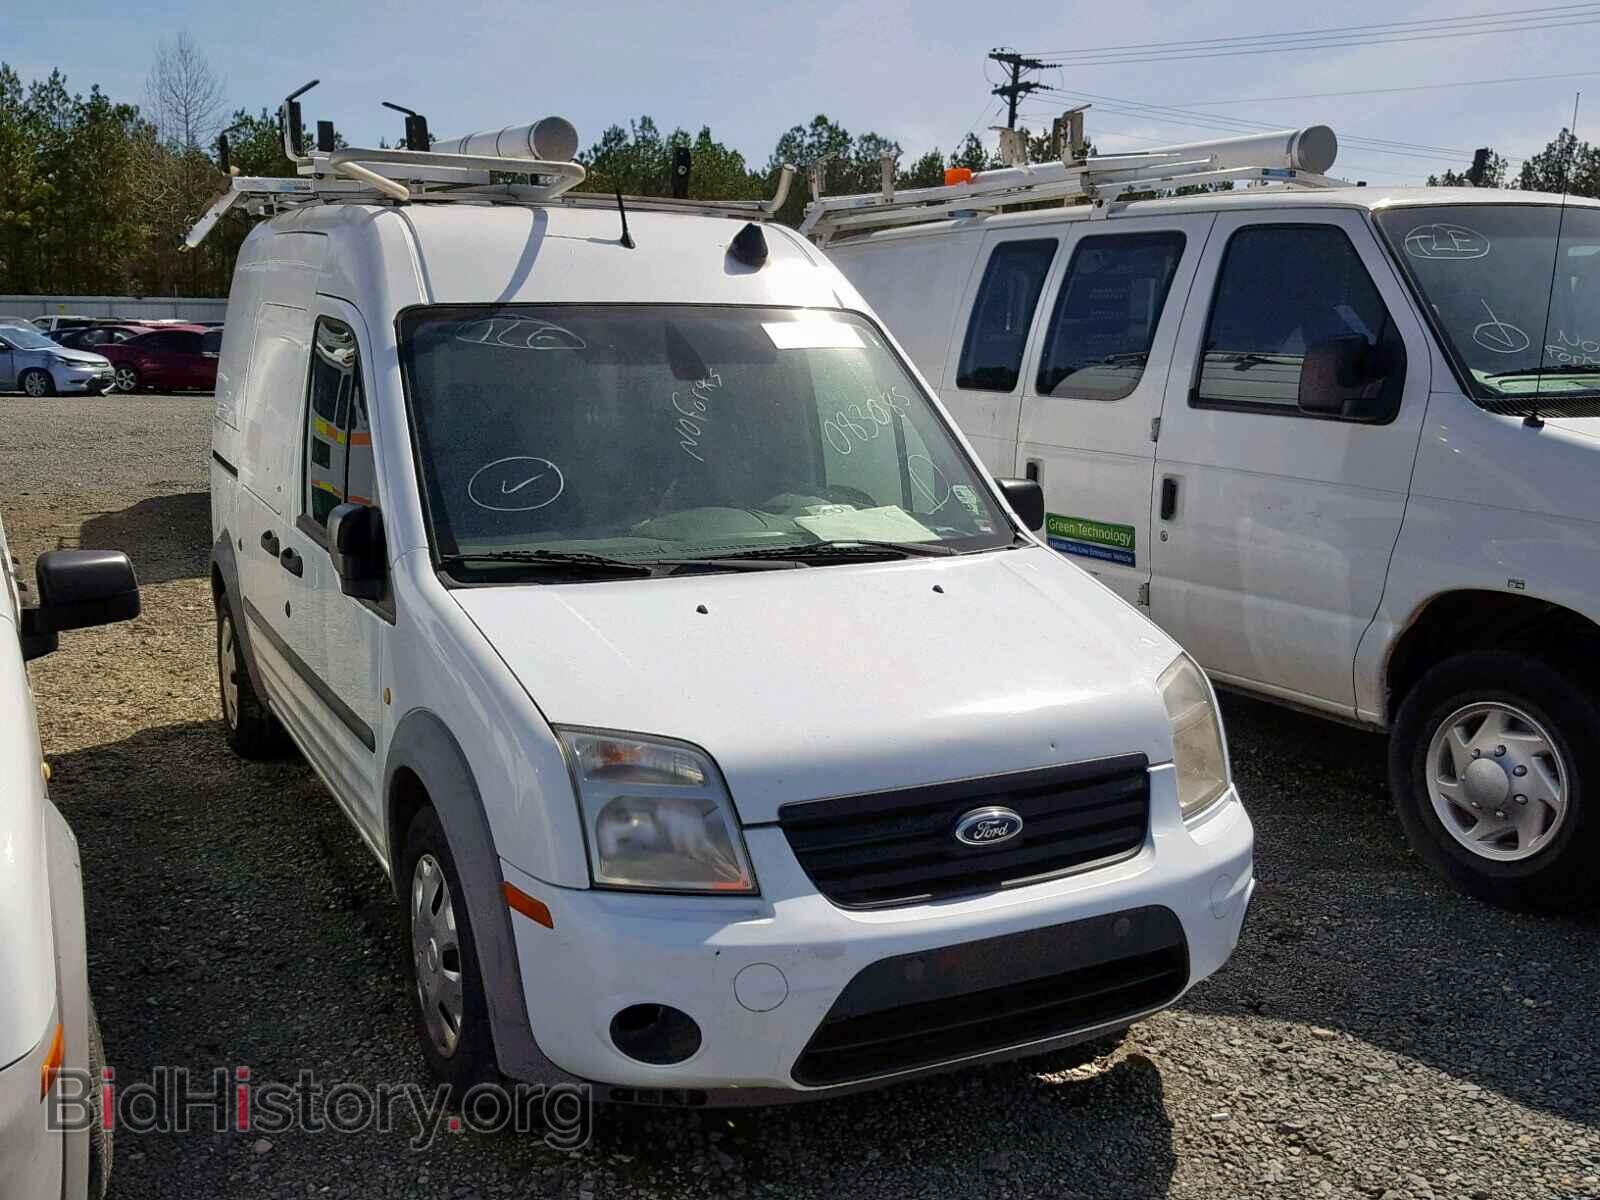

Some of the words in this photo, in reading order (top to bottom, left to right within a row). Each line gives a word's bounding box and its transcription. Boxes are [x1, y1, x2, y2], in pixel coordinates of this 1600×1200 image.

[1048, 518, 1074, 533] Green
[1078, 523, 1132, 546] Technology
[973, 819, 1009, 840] Ford
